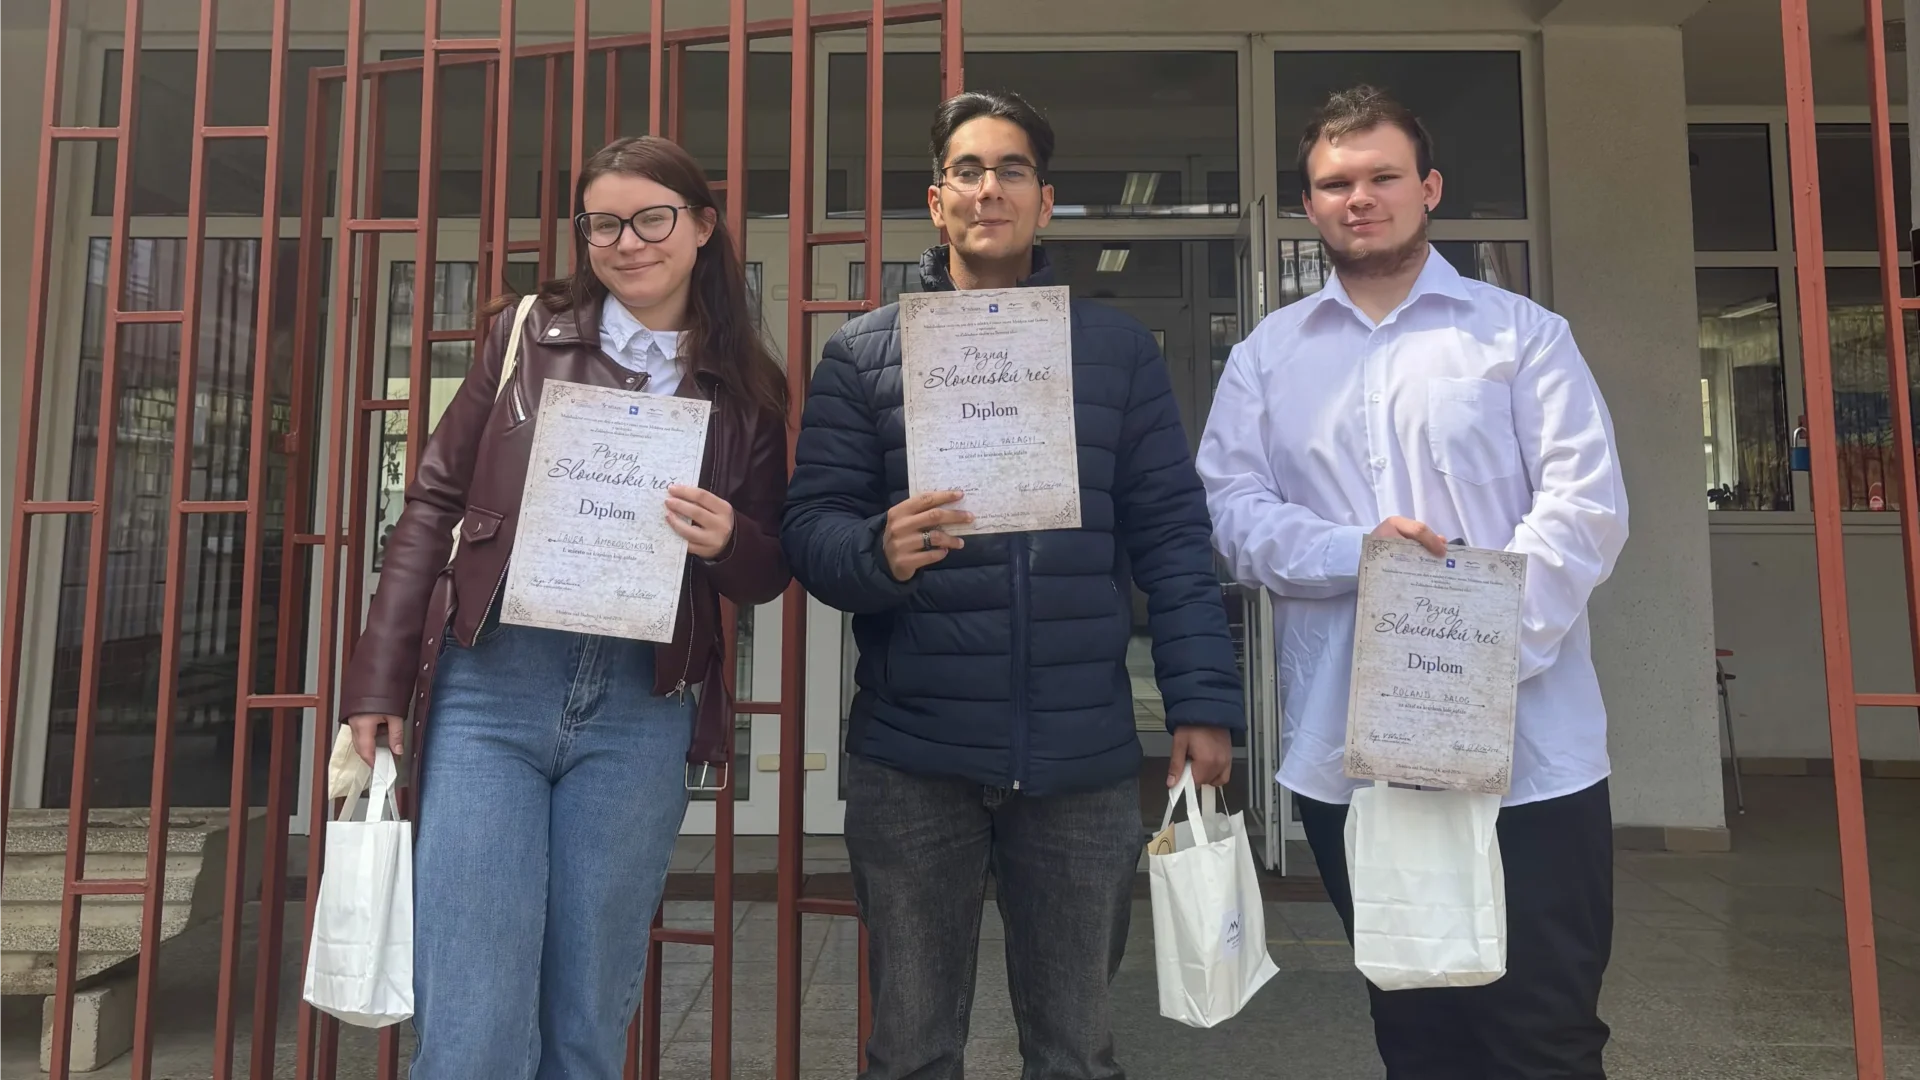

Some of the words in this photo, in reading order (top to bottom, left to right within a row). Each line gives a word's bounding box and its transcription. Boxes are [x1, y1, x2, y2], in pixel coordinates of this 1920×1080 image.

[961, 346, 1008, 371] Poznaj
[923, 361, 1021, 389] Slovenskú
[1025, 366, 1051, 381] reč
[961, 401, 1018, 420] Diplom
[592, 443, 639, 471] Poznaj
[548, 458, 646, 487] Slovenskú
[578, 498, 635, 521] Diplom
[1413, 597, 1461, 625] Poznaj
[1374, 613, 1472, 642] Slovenskú
[1473, 629, 1501, 645] reč
[1407, 652, 1463, 675] Diplom
[1392, 686, 1431, 698] ROLAND
[1444, 694, 1470, 704] BALOG
